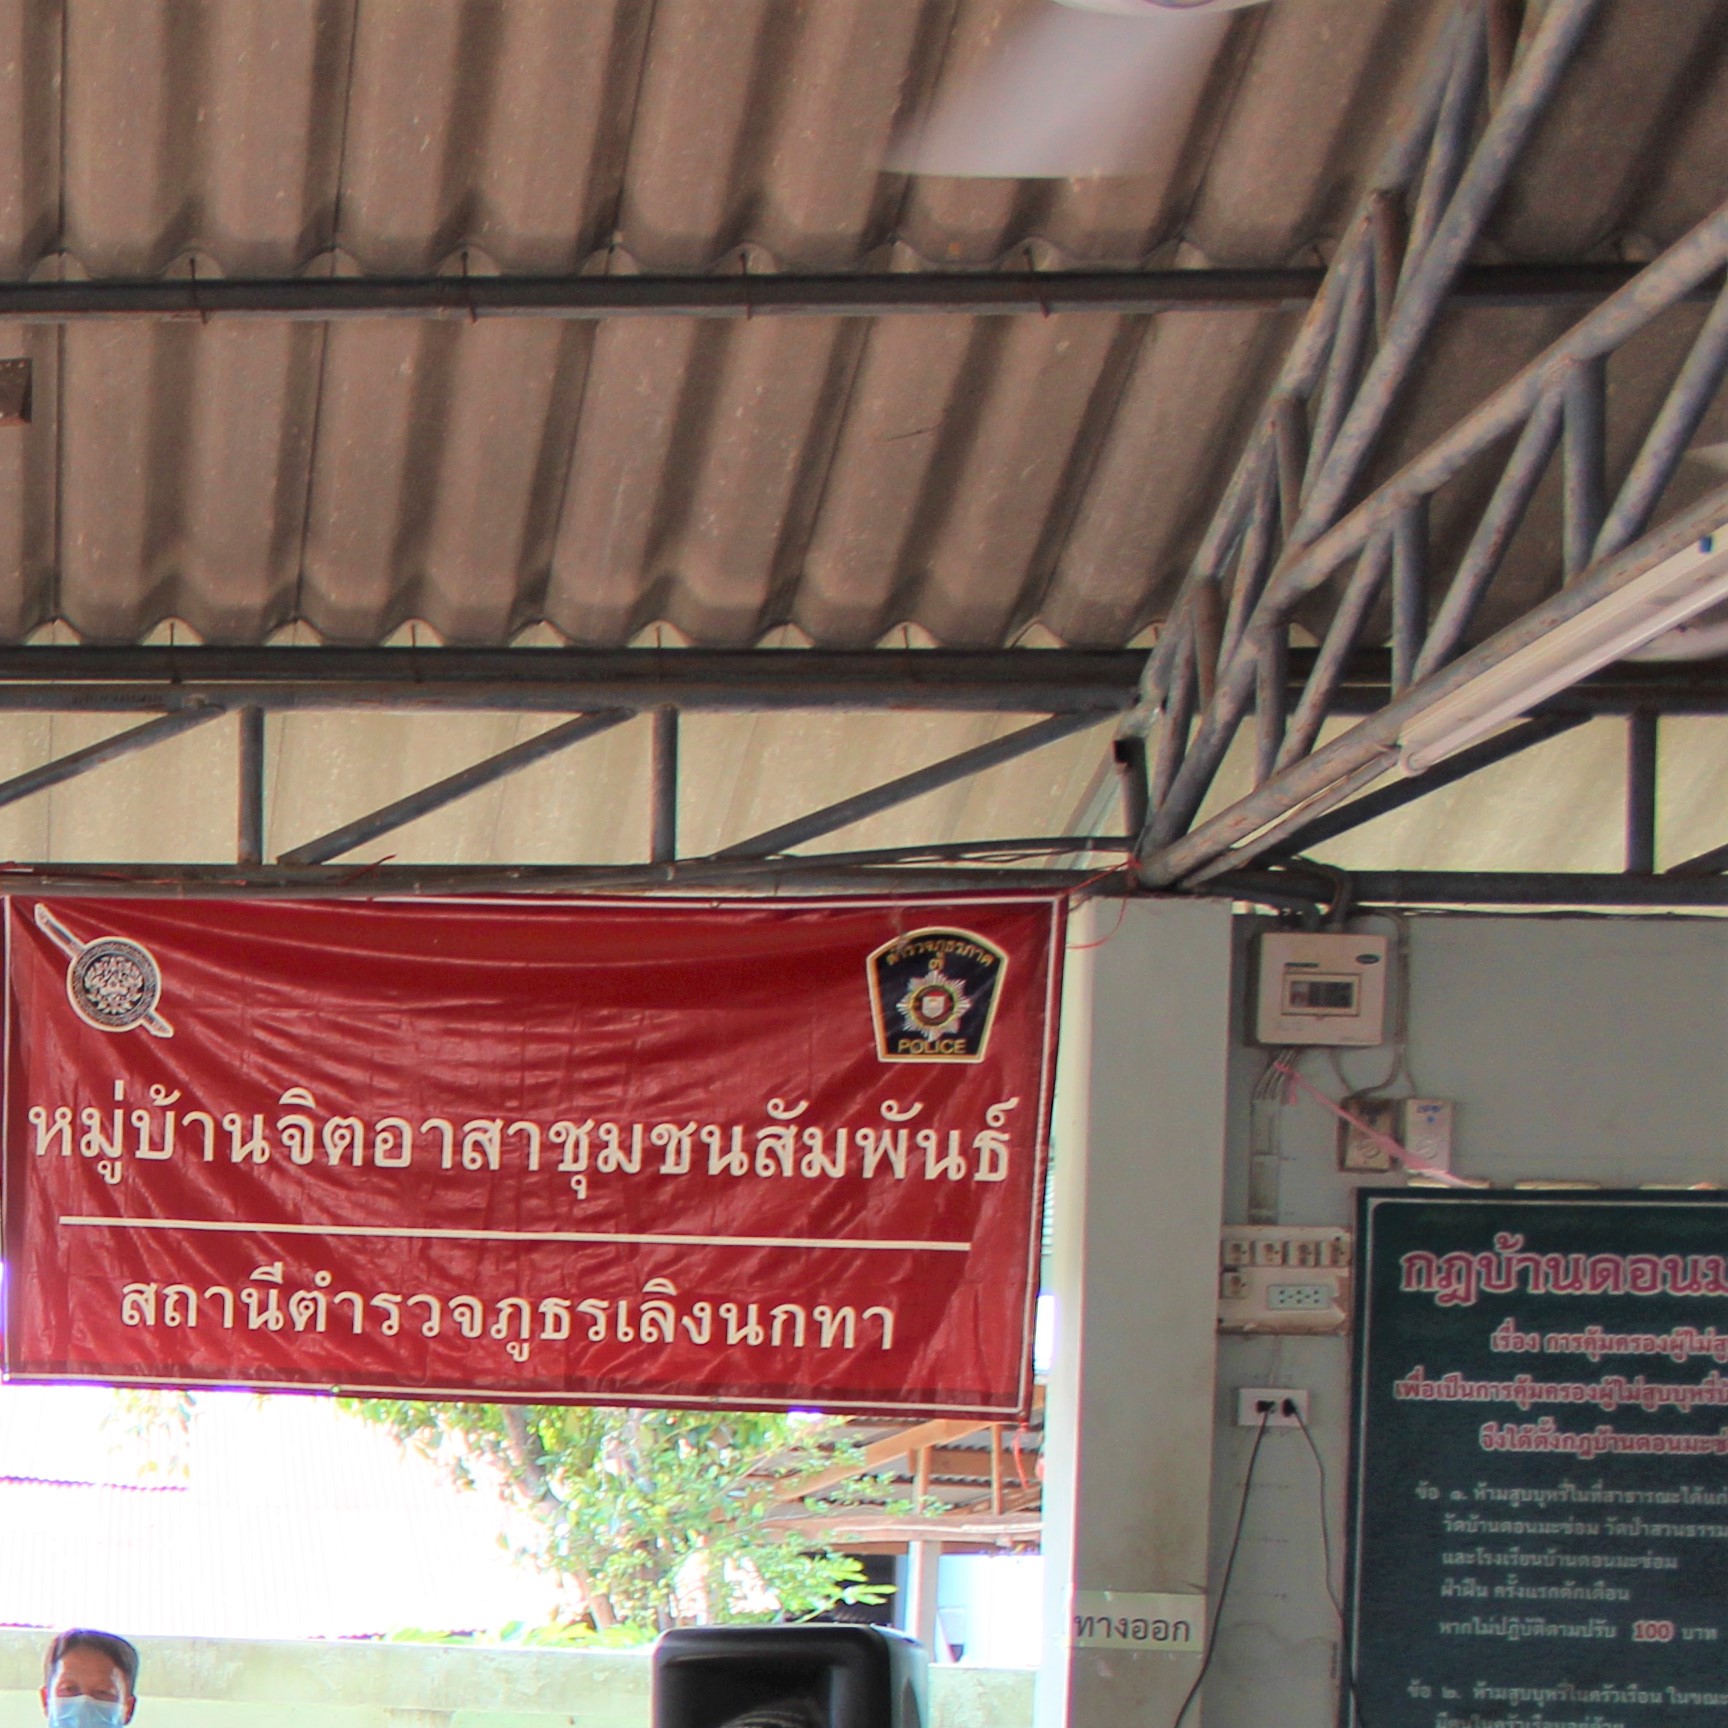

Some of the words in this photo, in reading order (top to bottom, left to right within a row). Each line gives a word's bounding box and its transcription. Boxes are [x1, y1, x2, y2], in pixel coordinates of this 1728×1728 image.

[897, 1038, 968, 1055] POLICE
[28, 1080, 1022, 1200] หมู่บ้านจิตอาสาชุมชนสัมพันธ์
[120, 1262, 897, 1362] สถานีตำรวจภูธรเลิงนกทา
[1489, 1317, 1542, 1355] เรื่อง
[1414, 1480, 1441, 1502] ข้อ
[1074, 1614, 1192, 1643] ทางออก
[1631, 1619, 1675, 1643] 100
[1680, 1624, 1719, 1642] บาท
